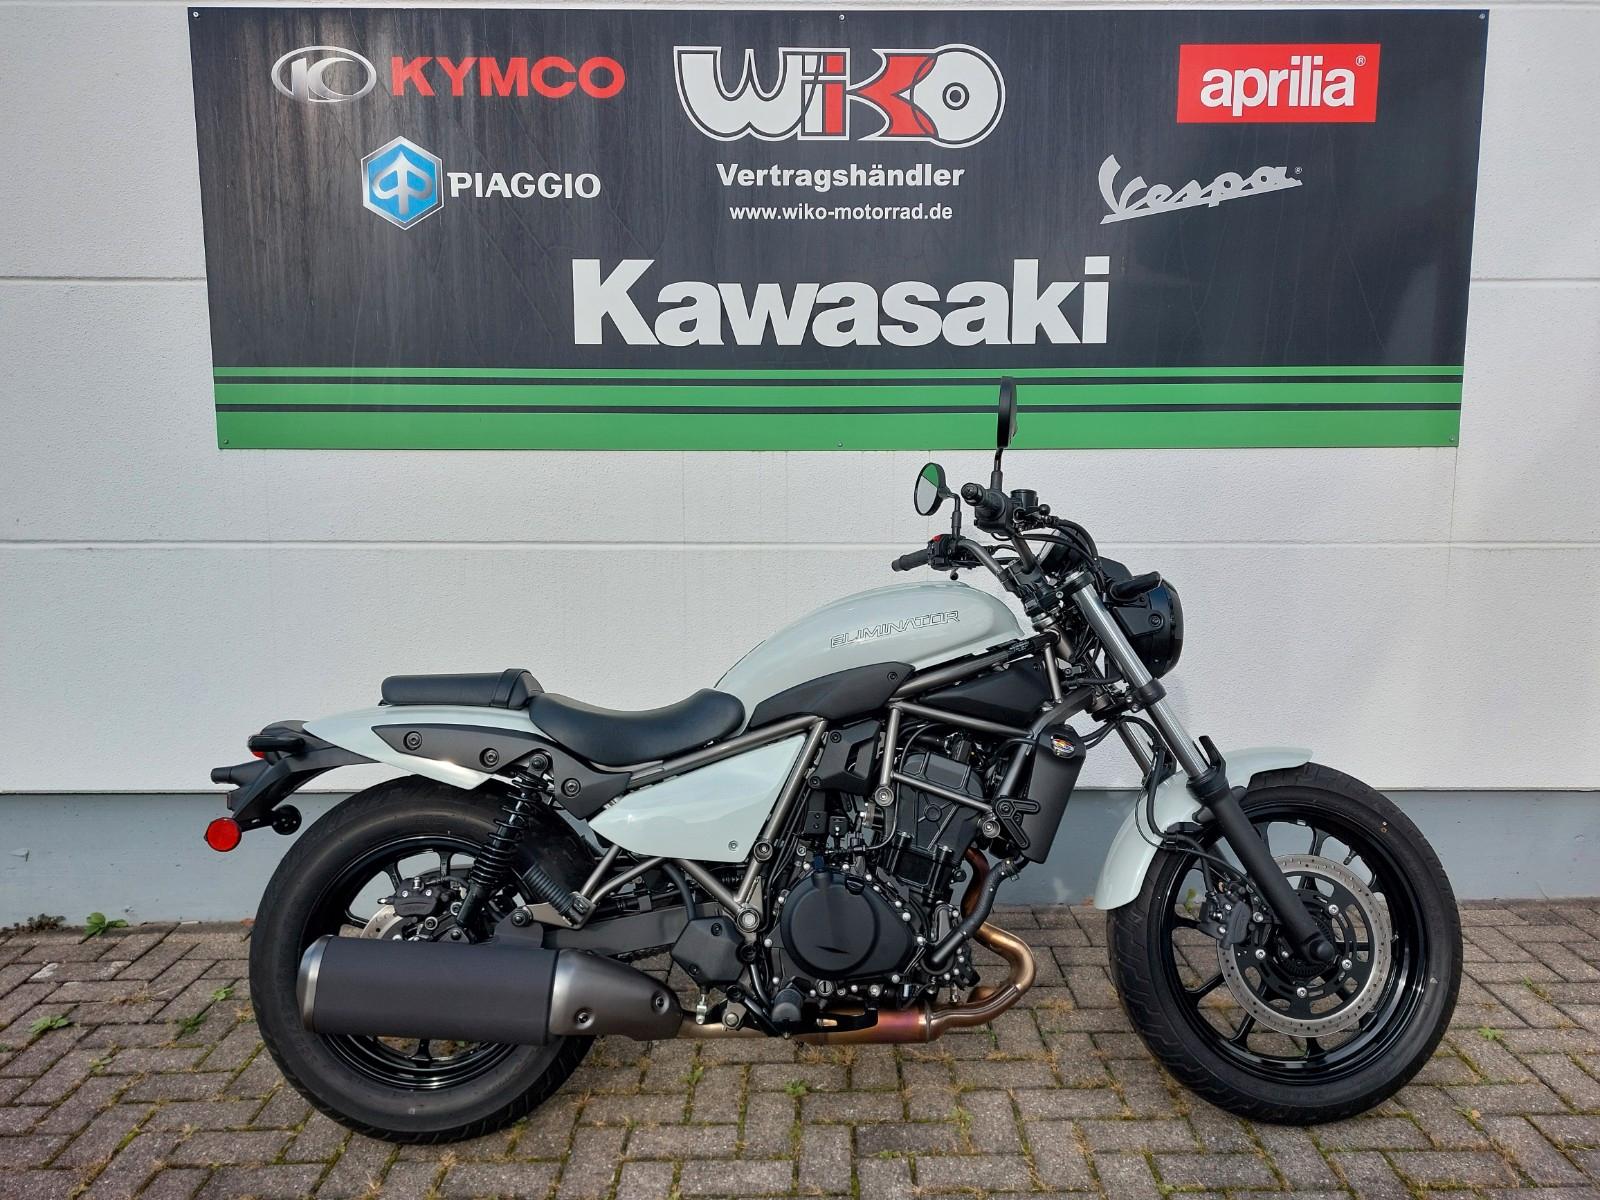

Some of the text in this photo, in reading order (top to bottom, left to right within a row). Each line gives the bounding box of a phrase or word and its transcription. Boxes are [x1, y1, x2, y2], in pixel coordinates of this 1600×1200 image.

[391, 56, 626, 99] KYMCO
[1200, 55, 1356, 117] aprilia
[446, 171, 601, 199] PIAGGIO
[716, 163, 965, 192] Vertragshändler
[1098, 154, 1303, 224] Vespa
[729, 203, 953, 221] www.wiko-motorrad.de
[571, 255, 1110, 348] Kawasaki
[830, 610, 961, 649] ELIMINATOR
